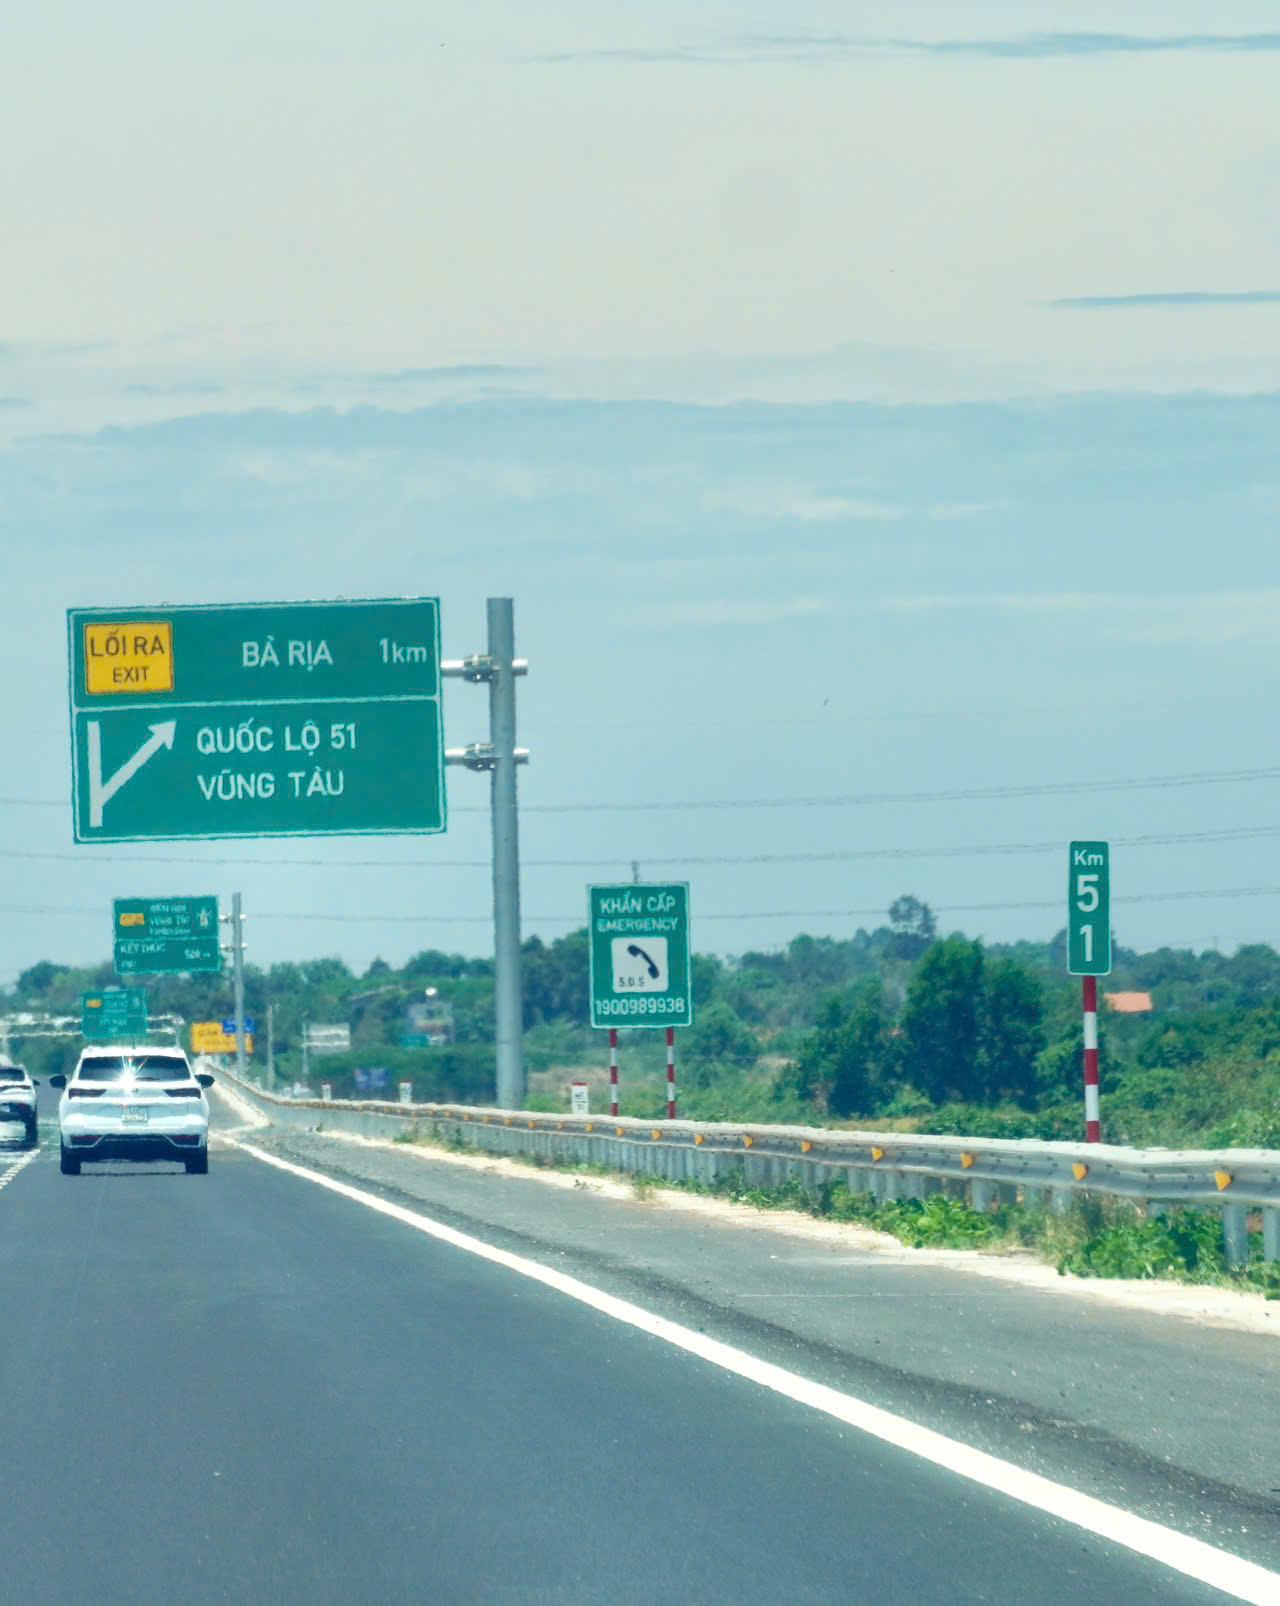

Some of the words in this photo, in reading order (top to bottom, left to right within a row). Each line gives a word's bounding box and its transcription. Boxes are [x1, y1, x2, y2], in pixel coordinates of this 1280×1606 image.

[90, 629, 126, 656] LỐI
[134, 635, 165, 655] RA
[242, 635, 279, 667] BÀ
[288, 640, 333, 672] RỊA
[113, 666, 149, 683] EXIT
[196, 717, 274, 755] QUỐC
[284, 720, 320, 756] LỘ
[330, 723, 356, 749] 51
[196, 769, 275, 800] VŨNG
[287, 766, 344, 797] TÀU
[1073, 849, 1103, 866] Km
[1076, 874, 1099, 913] 5
[597, 917, 678, 932] EMERGENCY
[1080, 924, 1093, 962] 1
[595, 998, 685, 1015] 1900989938
